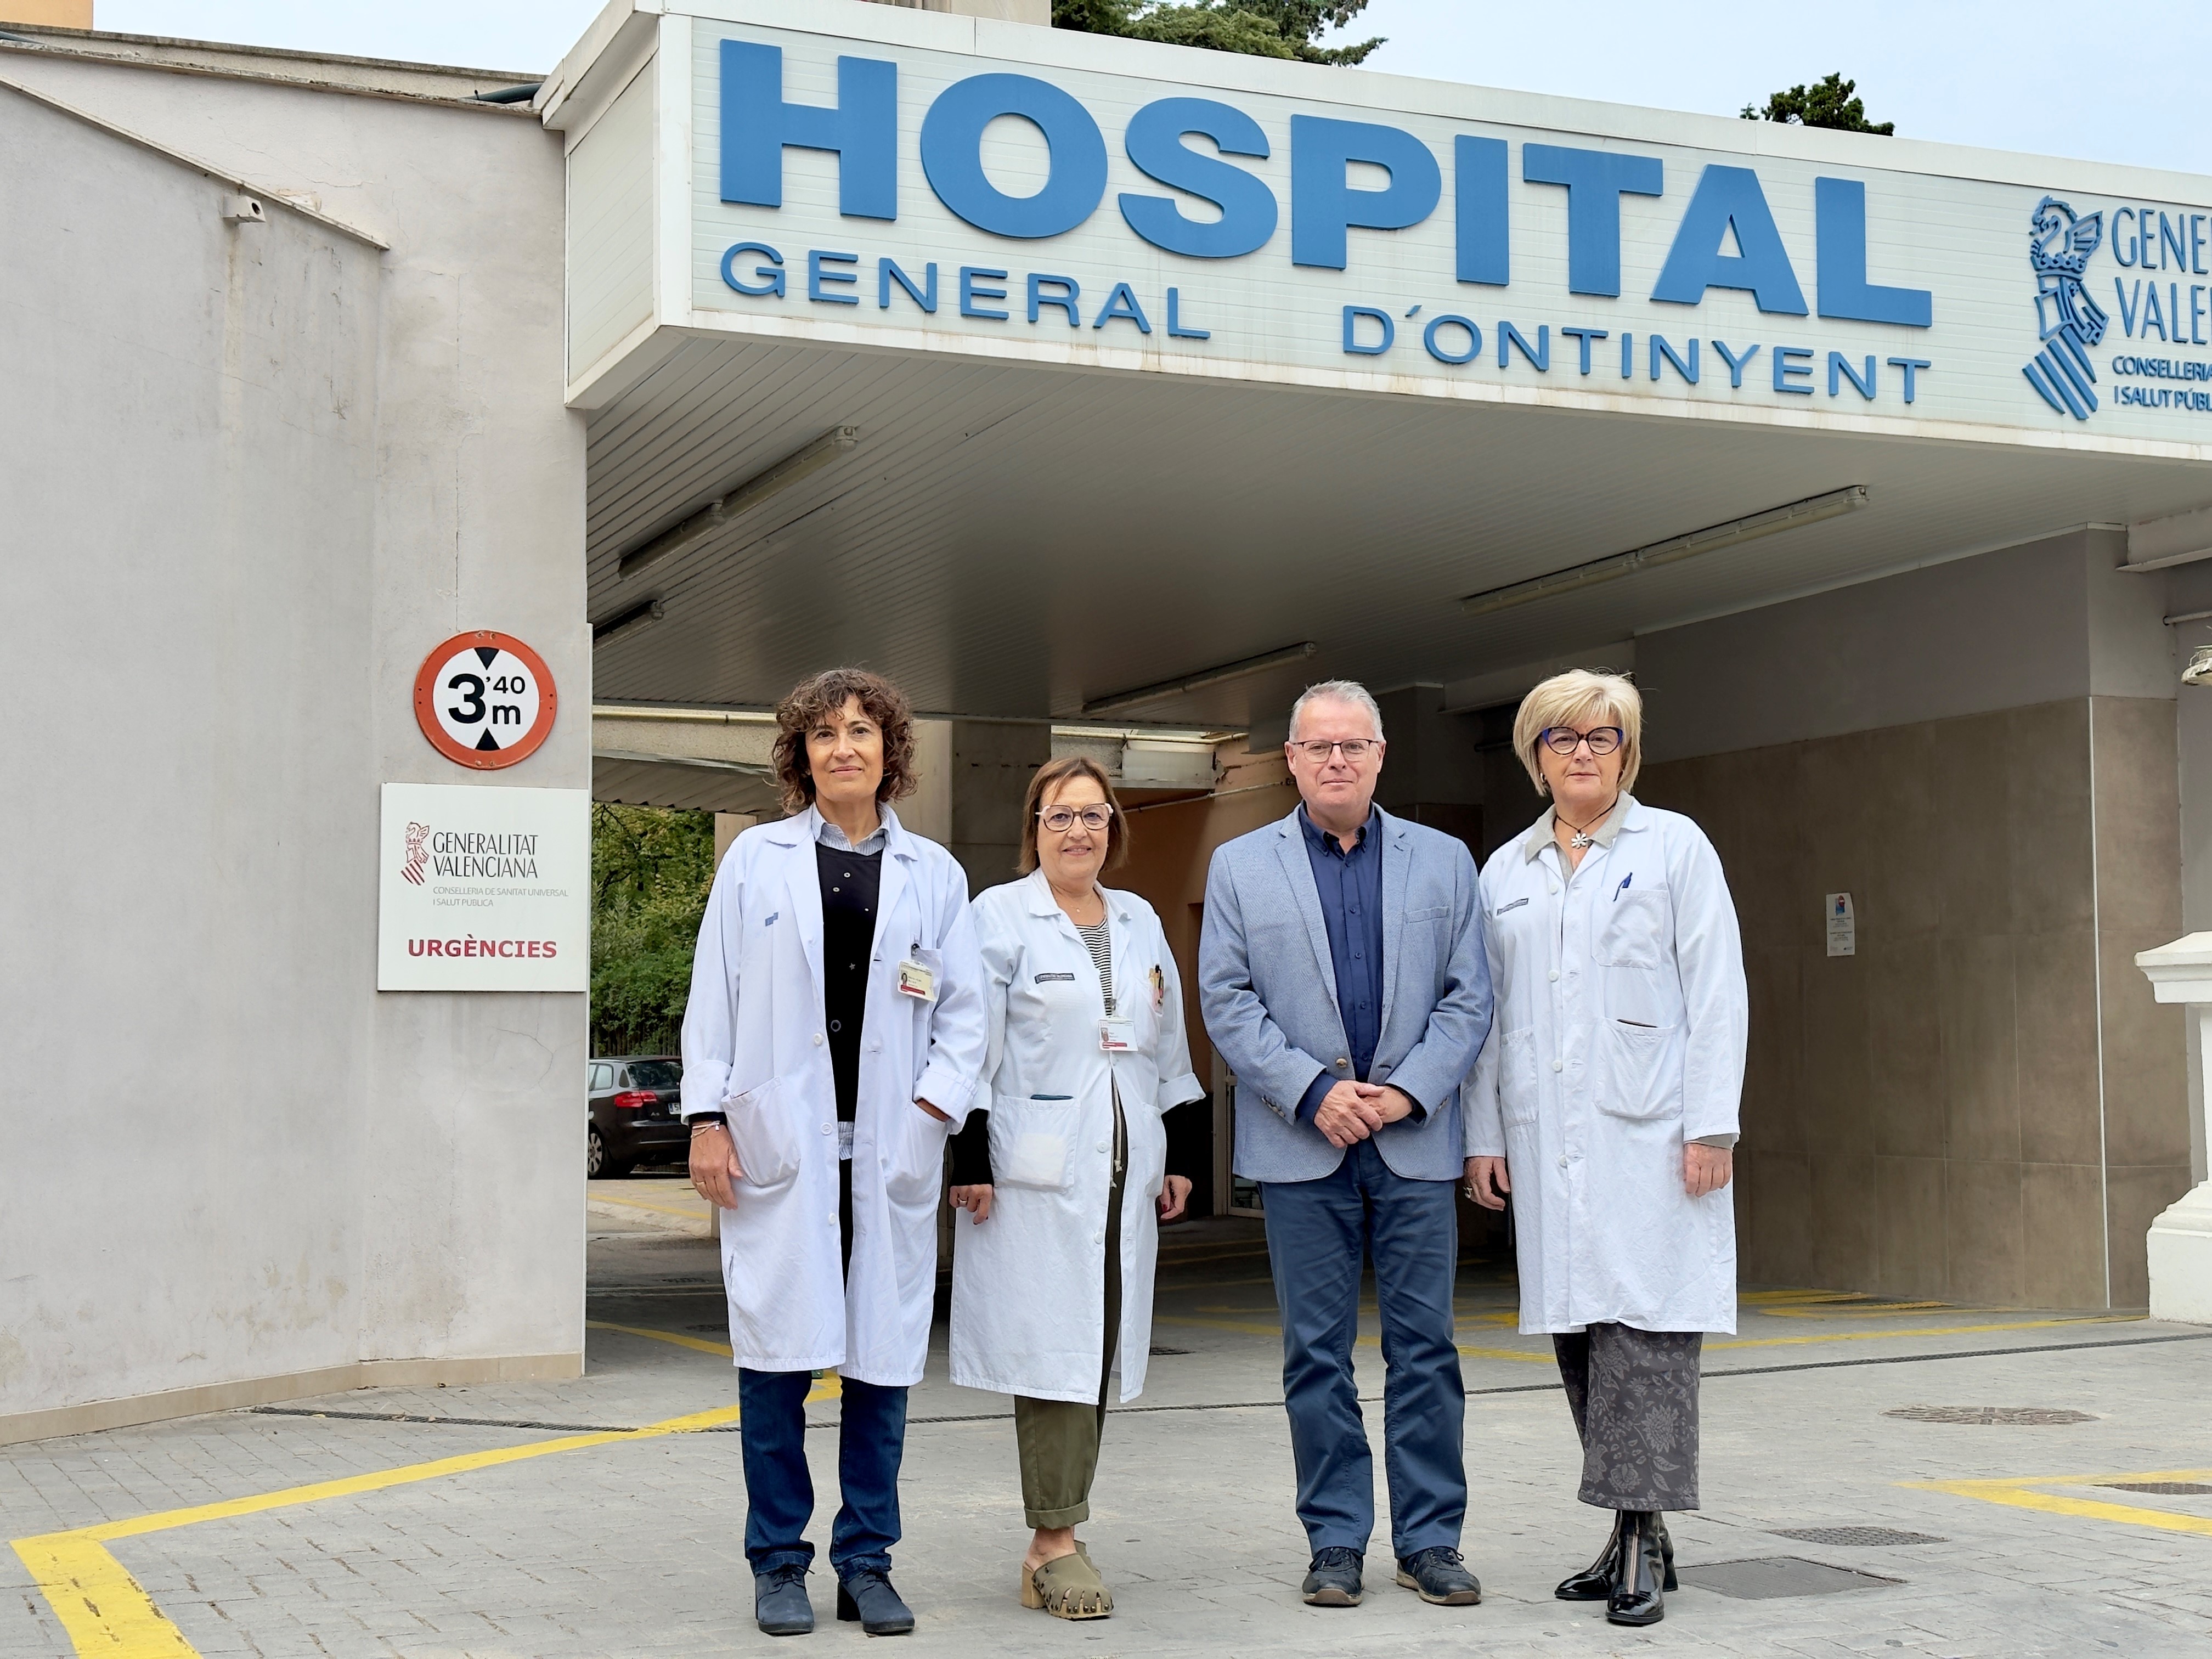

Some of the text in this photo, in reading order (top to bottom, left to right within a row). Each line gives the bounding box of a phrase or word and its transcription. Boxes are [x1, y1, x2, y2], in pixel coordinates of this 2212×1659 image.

[719, 38, 1933, 329] HOSPITAL
[2112, 207, 2212, 274] GENE
[720, 242, 1210, 340] GENERAL
[2114, 276, 2212, 345] VALE
[2114, 385, 2118, 404] I
[2121, 386, 2172, 408] SALUT
[493, 705, 521, 725] m
[433, 832, 538, 855] GENERALITAT
[433, 855, 538, 879] VALENCIANA
[433, 886, 483, 895] CONSELLERIA
[496, 888, 527, 896] SANITAT
[528, 889, 568, 897] UNIVERSAL
[408, 934, 557, 958] URGÈNCIES
